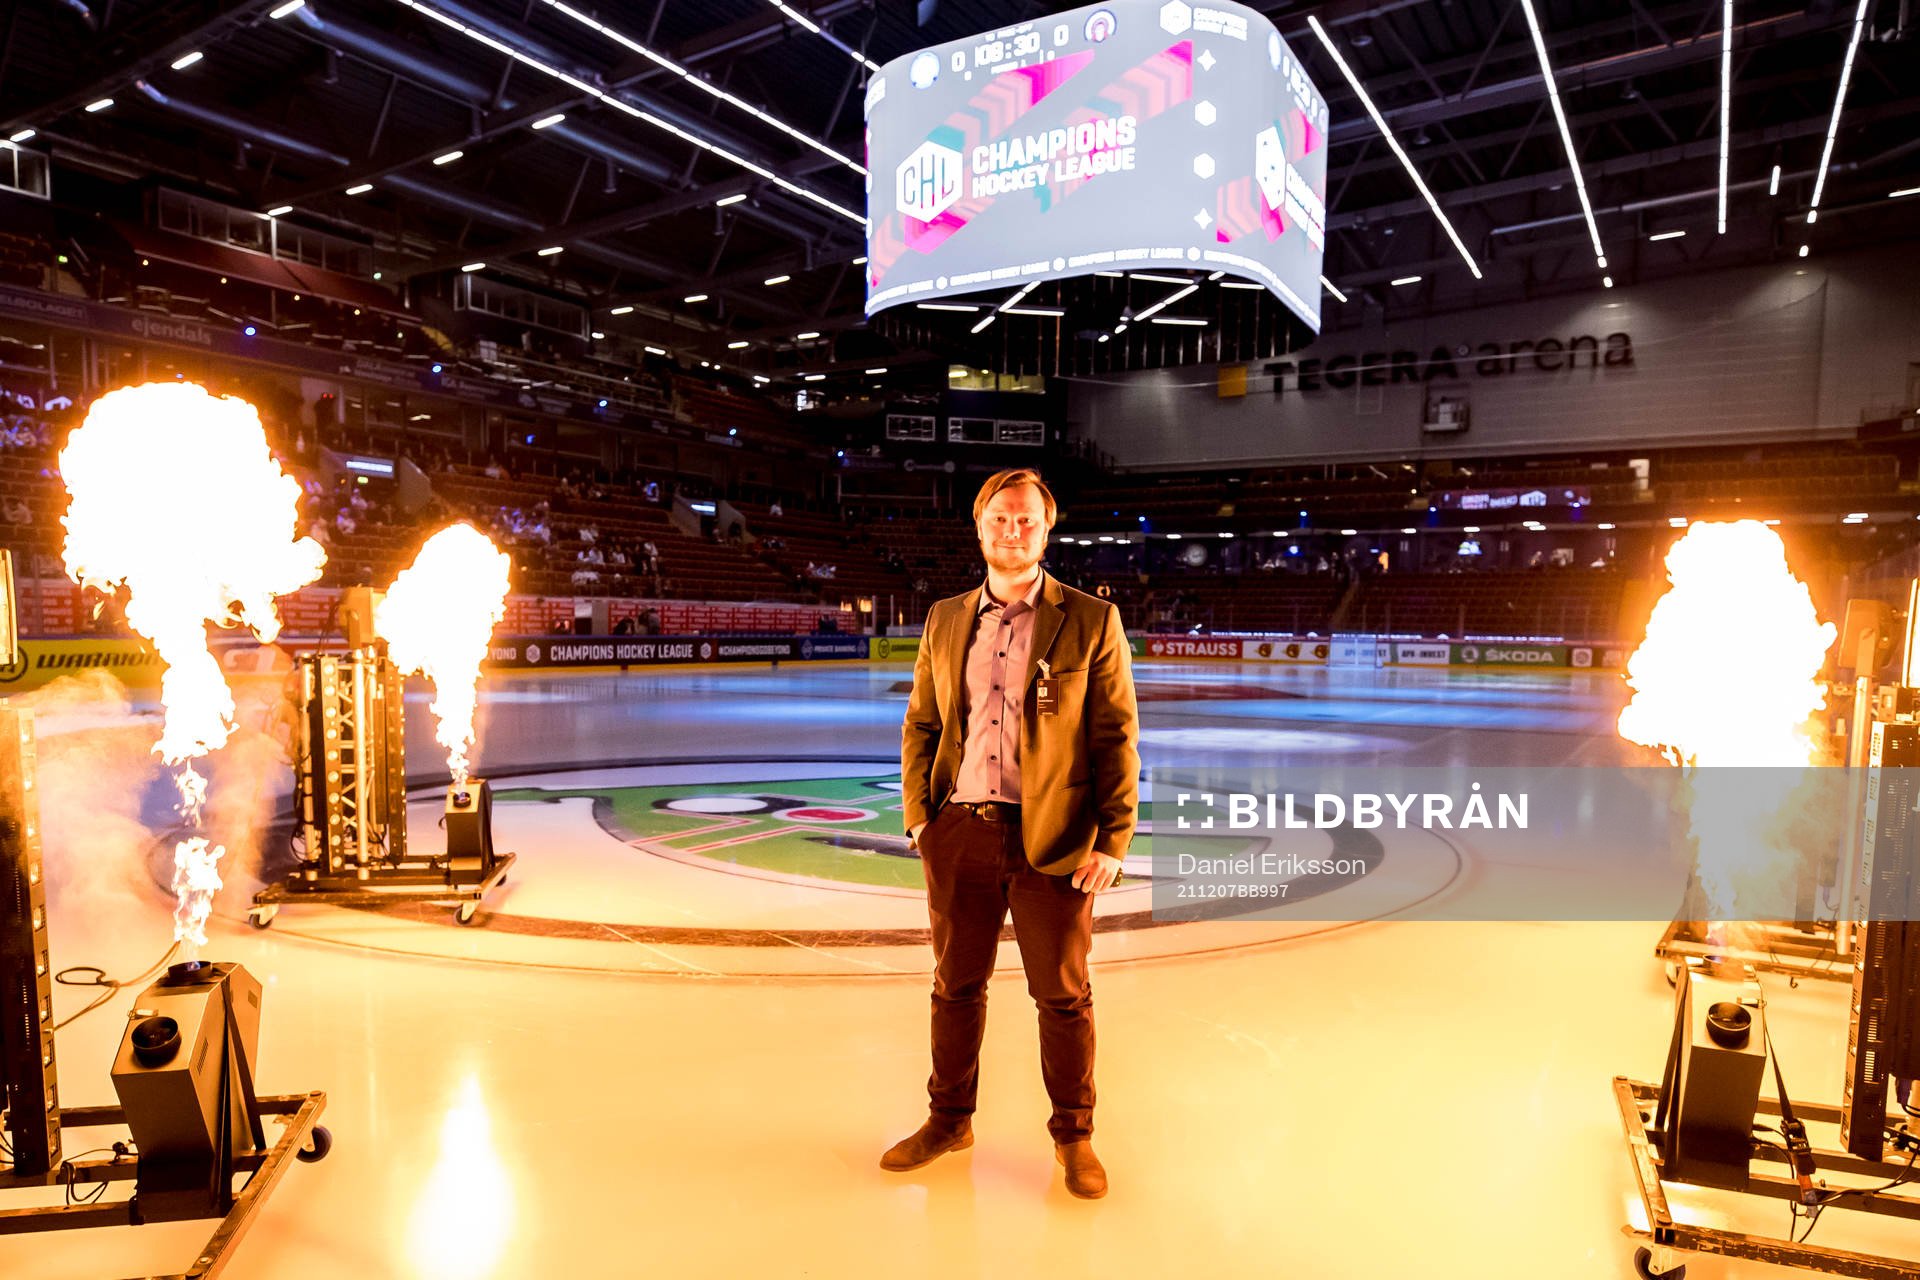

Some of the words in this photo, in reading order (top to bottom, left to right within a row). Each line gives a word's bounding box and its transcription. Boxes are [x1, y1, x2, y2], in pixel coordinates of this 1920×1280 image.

[972, 115, 1137, 175] CHAMPIONS
[972, 163, 1049, 199] HOCKEY
[1054, 147, 1136, 183] LEAGUE
[131, 316, 212, 345] ejendals
[1263, 346, 1459, 392] TEGERA
[1476, 331, 1635, 377] arena
[550, 645, 614, 661] CHAMPIONS
[617, 644, 656, 659] HOCKEY
[658, 643, 693, 658] LEAGUE
[1165, 641, 1238, 657] STRAUSS
[1485, 648, 1554, 663] ŠKODA
